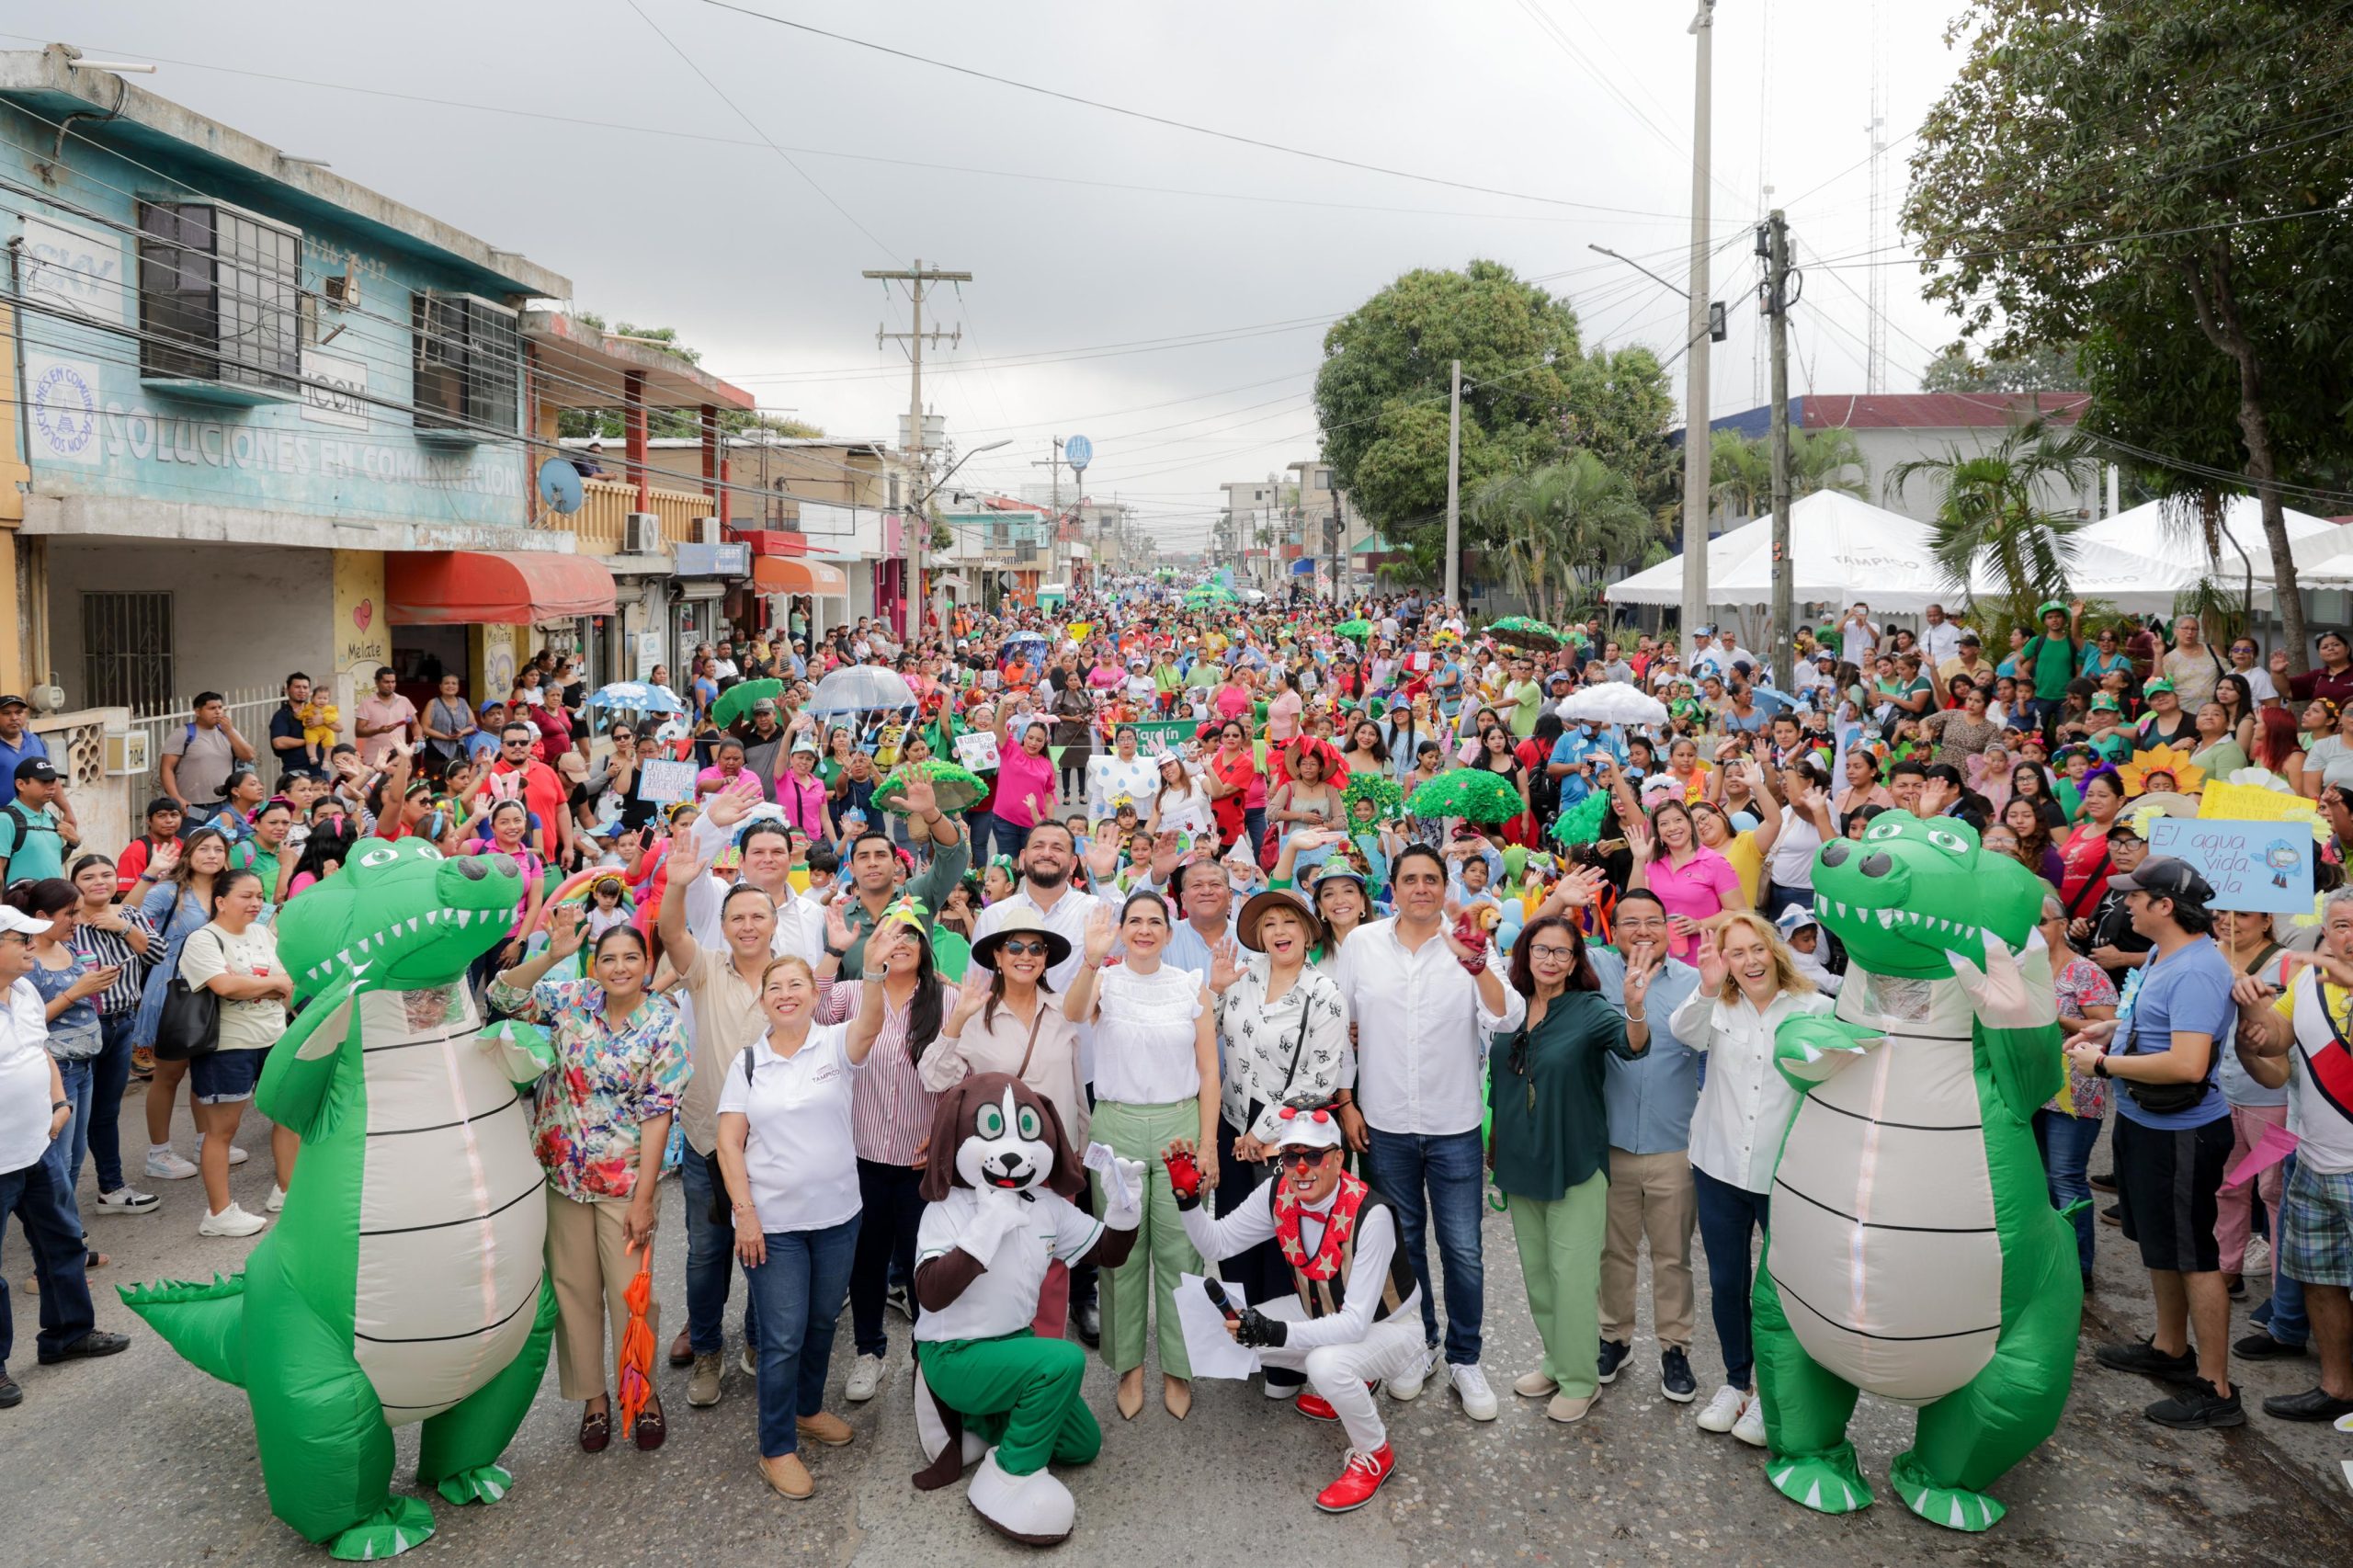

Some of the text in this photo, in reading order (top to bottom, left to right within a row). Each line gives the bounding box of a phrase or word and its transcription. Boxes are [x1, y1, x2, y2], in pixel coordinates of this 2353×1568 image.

[105, 401, 311, 476] SOLUCIONES
[319, 437, 355, 480] EN
[1831, 555, 1919, 569] TAMPICO
[347, 640, 381, 660] Melate
[2153, 824, 2245, 858] El agua
[2204, 851, 2250, 873] vida.
[812, 1069, 840, 1083] TAMPICO
